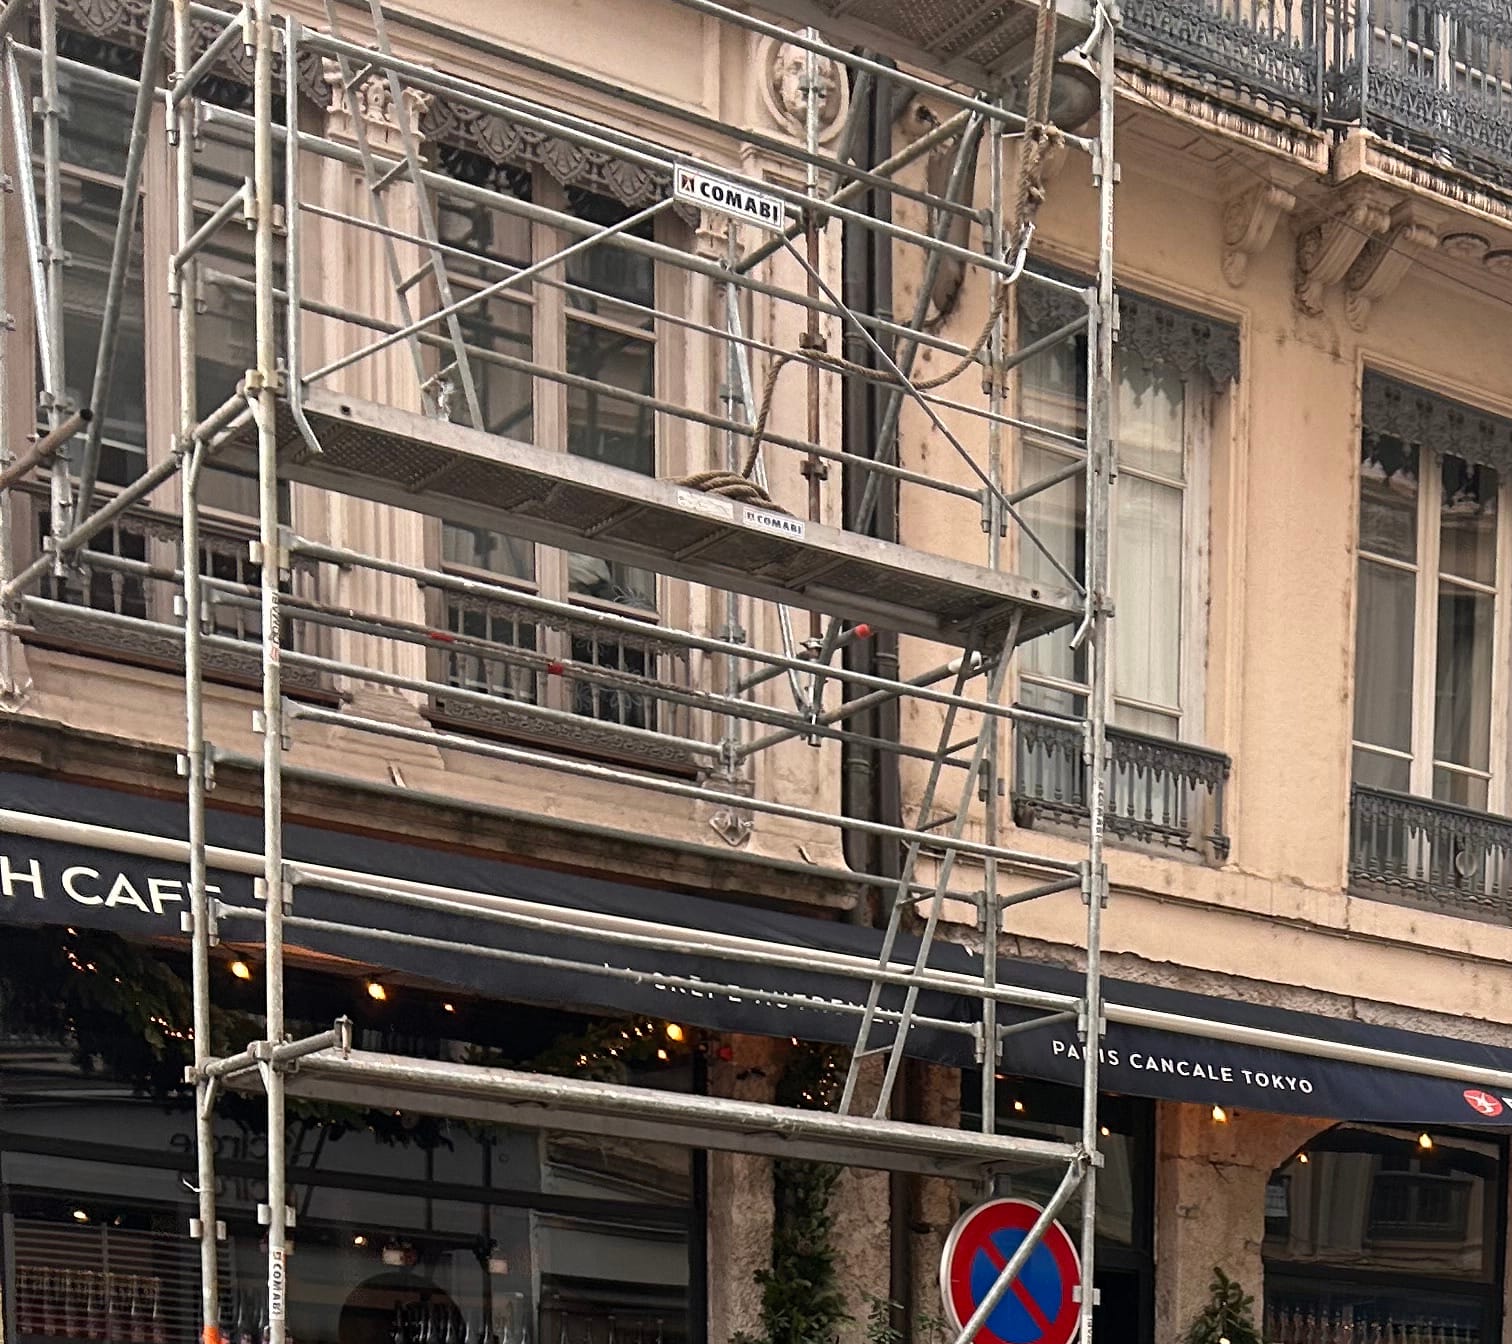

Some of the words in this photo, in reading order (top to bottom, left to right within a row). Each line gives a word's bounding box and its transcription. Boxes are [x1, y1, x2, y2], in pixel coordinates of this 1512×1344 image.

[700, 181, 779, 223] COMABI
[757, 514, 802, 535] COMABI
[1052, 1040, 1120, 1066] PAIS
[1129, 1053, 1234, 1083] CANCALE
[1241, 1070, 1314, 1094] TOKYO
